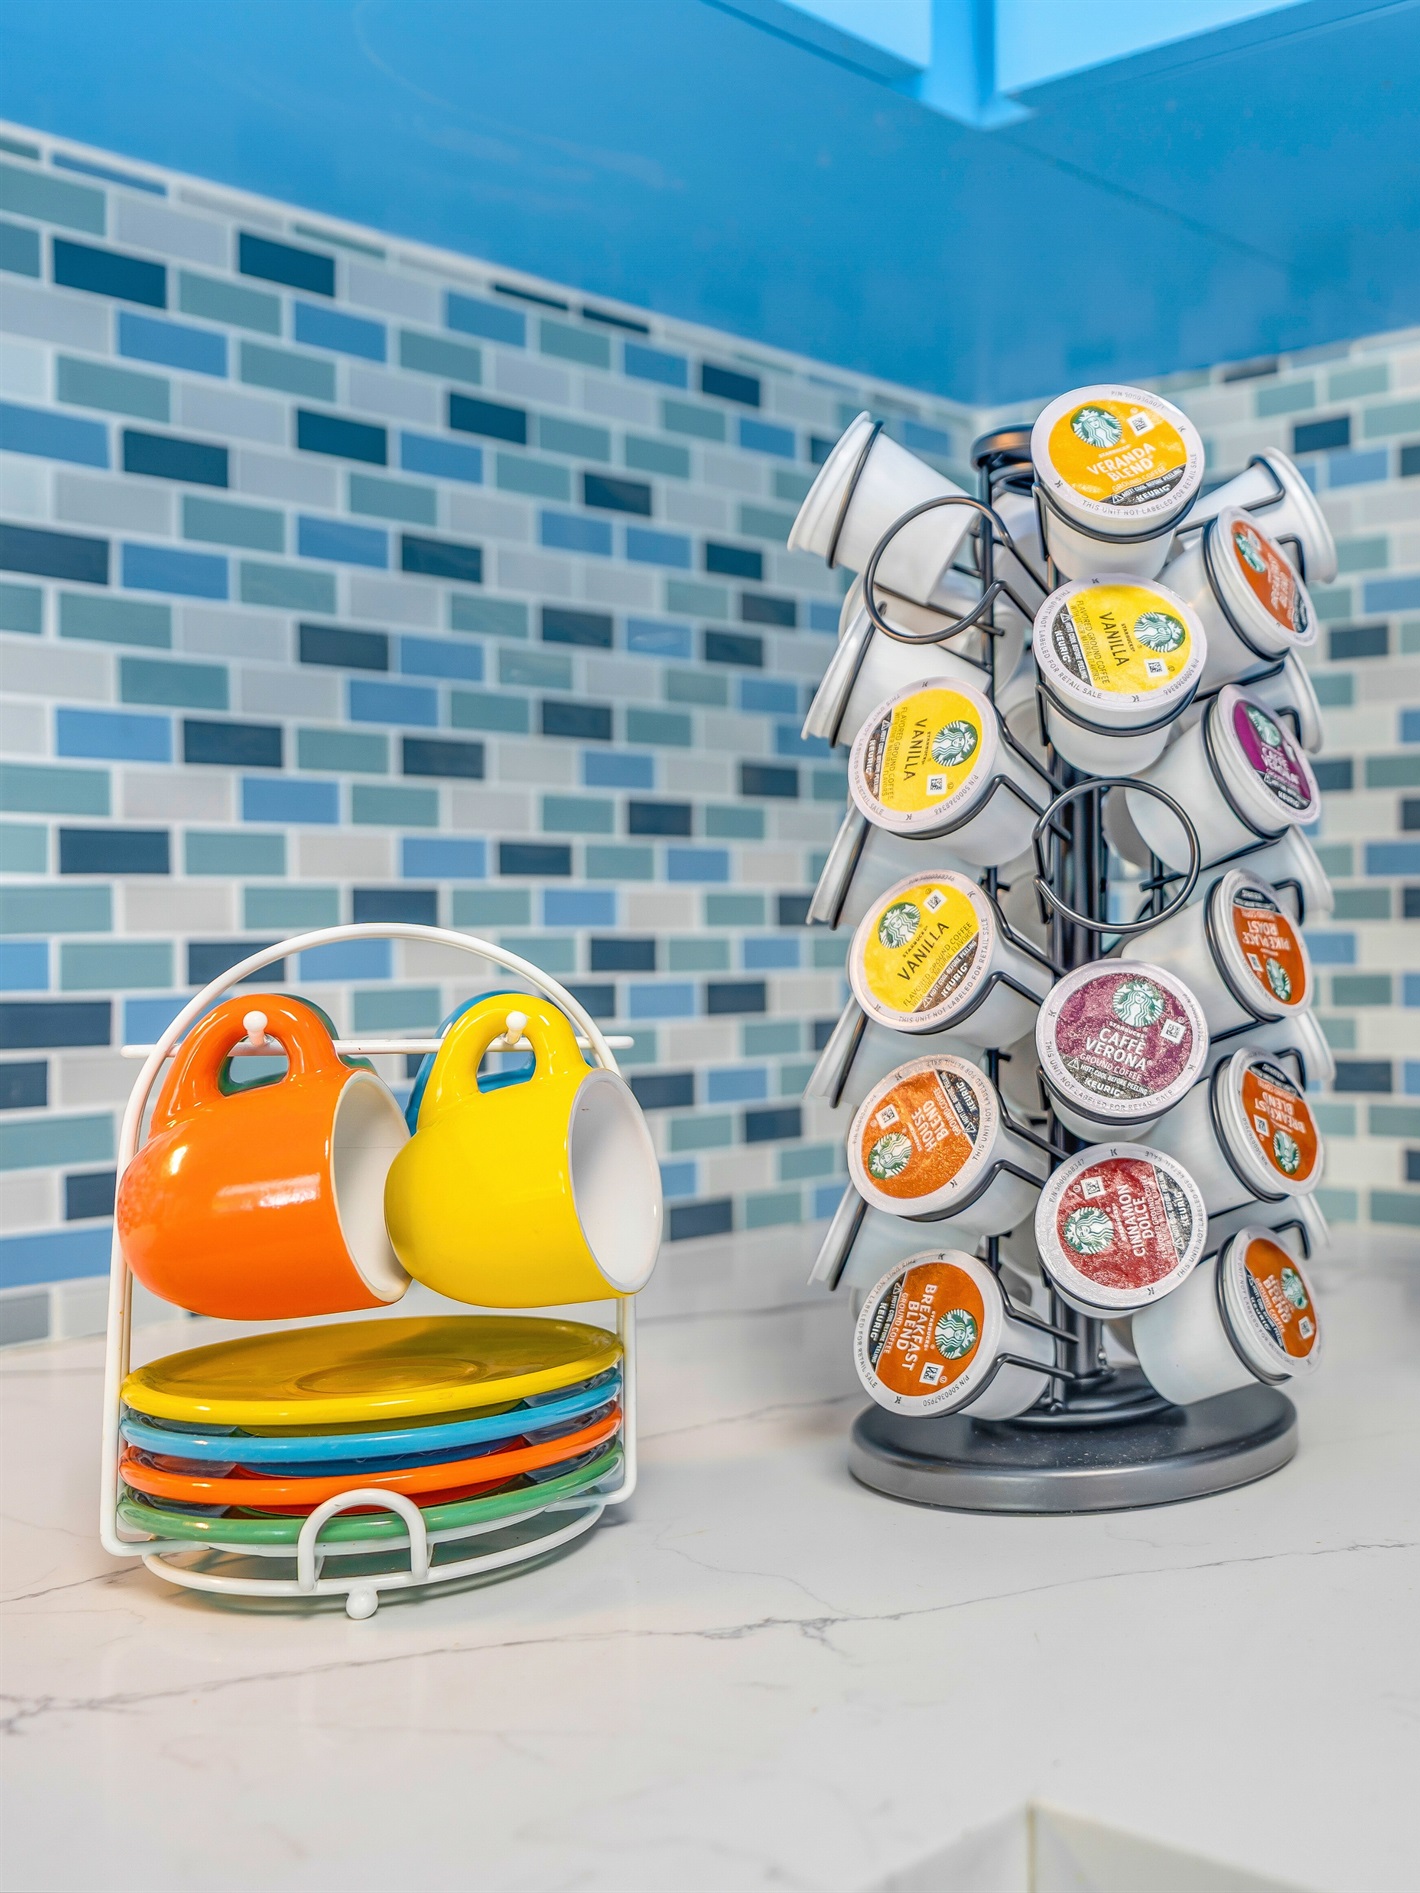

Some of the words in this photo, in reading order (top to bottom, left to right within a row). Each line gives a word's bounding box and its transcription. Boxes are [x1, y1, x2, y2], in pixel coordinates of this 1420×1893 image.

[1087, 443, 1156, 475] VERANDA
[1107, 457, 1153, 482] BLEND
[1142, 467, 1167, 481] COFFEE
[1189, 454, 1197, 469] SALE
[1132, 485, 1170, 503] KEURIG
[1173, 489, 1185, 501] FOR
[1183, 468, 1196, 491] RETAIL
[1082, 500, 1099, 511] THIS
[1142, 499, 1173, 514] LABELED
[1039, 615, 1048, 629] NOT
[1039, 630, 1050, 660] LABELED
[1054, 630, 1071, 664] KEURIG
[1076, 600, 1092, 632] FLAVORED
[1087, 632, 1102, 659] GROUND
[1096, 659, 1110, 684] COFFEE
[1099, 612, 1130, 666] VANILLA
[1048, 660, 1059, 673] FOR
[1058, 672, 1081, 692] RETAIL
[1082, 688, 1102, 699] SALE
[896, 706, 908, 744] FLAVORED
[865, 739, 877, 774] KEURIG
[889, 742, 900, 771] GROUND
[903, 718, 928, 781] VANILLA
[886, 772, 895, 800] COFFEE
[968, 774, 979, 787] P/N
[1248, 921, 1278, 936] ROAST
[897, 922, 950, 981] VANILLA
[903, 973, 933, 1007] FLAVORED
[929, 945, 951, 973] GROUND
[949, 921, 972, 944] COFFEE
[933, 1008, 947, 1017] NOT
[948, 981, 974, 1010] LABELED
[972, 966, 982, 980] FOR
[979, 939, 988, 964] RETAIL
[941, 962, 969, 997] KEURIG
[1109, 1021, 1147, 1038] STARBUCKS
[1045, 1041, 1053, 1058] THIS
[1050, 1059, 1062, 1077] UNIT
[1061, 1076, 1074, 1091] NOT
[1079, 1053, 1113, 1071] GROUND
[1114, 1065, 1143, 1081] COFFEE
[1085, 1037, 1147, 1071] VERONA
[955, 1081, 978, 1112] KEURIG
[1085, 1077, 1124, 1096] KEURIG
[1255, 1098, 1306, 1134] BREAKFAST
[1262, 1092, 1294, 1115] BLEND
[911, 1107, 937, 1152] HOUSE
[922, 1099, 949, 1141] BLEND
[972, 1144, 985, 1161] THIS
[983, 1123, 991, 1143] UNIT
[1117, 1184, 1146, 1257] CINNAMON
[1132, 1196, 1153, 1240] DOLCE
[1174, 1191, 1191, 1227] KEURIG
[1191, 1190, 1205, 1228] LABELED
[1189, 1245, 1200, 1263] UNIT
[1177, 1264, 1191, 1279] THIS
[858, 1295, 874, 1330] LABELED
[870, 1302, 888, 1342] KEURIG
[895, 1292, 909, 1330] GROUND
[896, 1300, 920, 1351] BLEND
[884, 1328, 899, 1354] COFFEE
[901, 1284, 938, 1371] BREAKFAST
[924, 1310, 936, 1351] STARBUCKS
[858, 1347, 866, 1373] RETAIL
[865, 1373, 878, 1388] SALE
[959, 1375, 970, 1386] P/N
